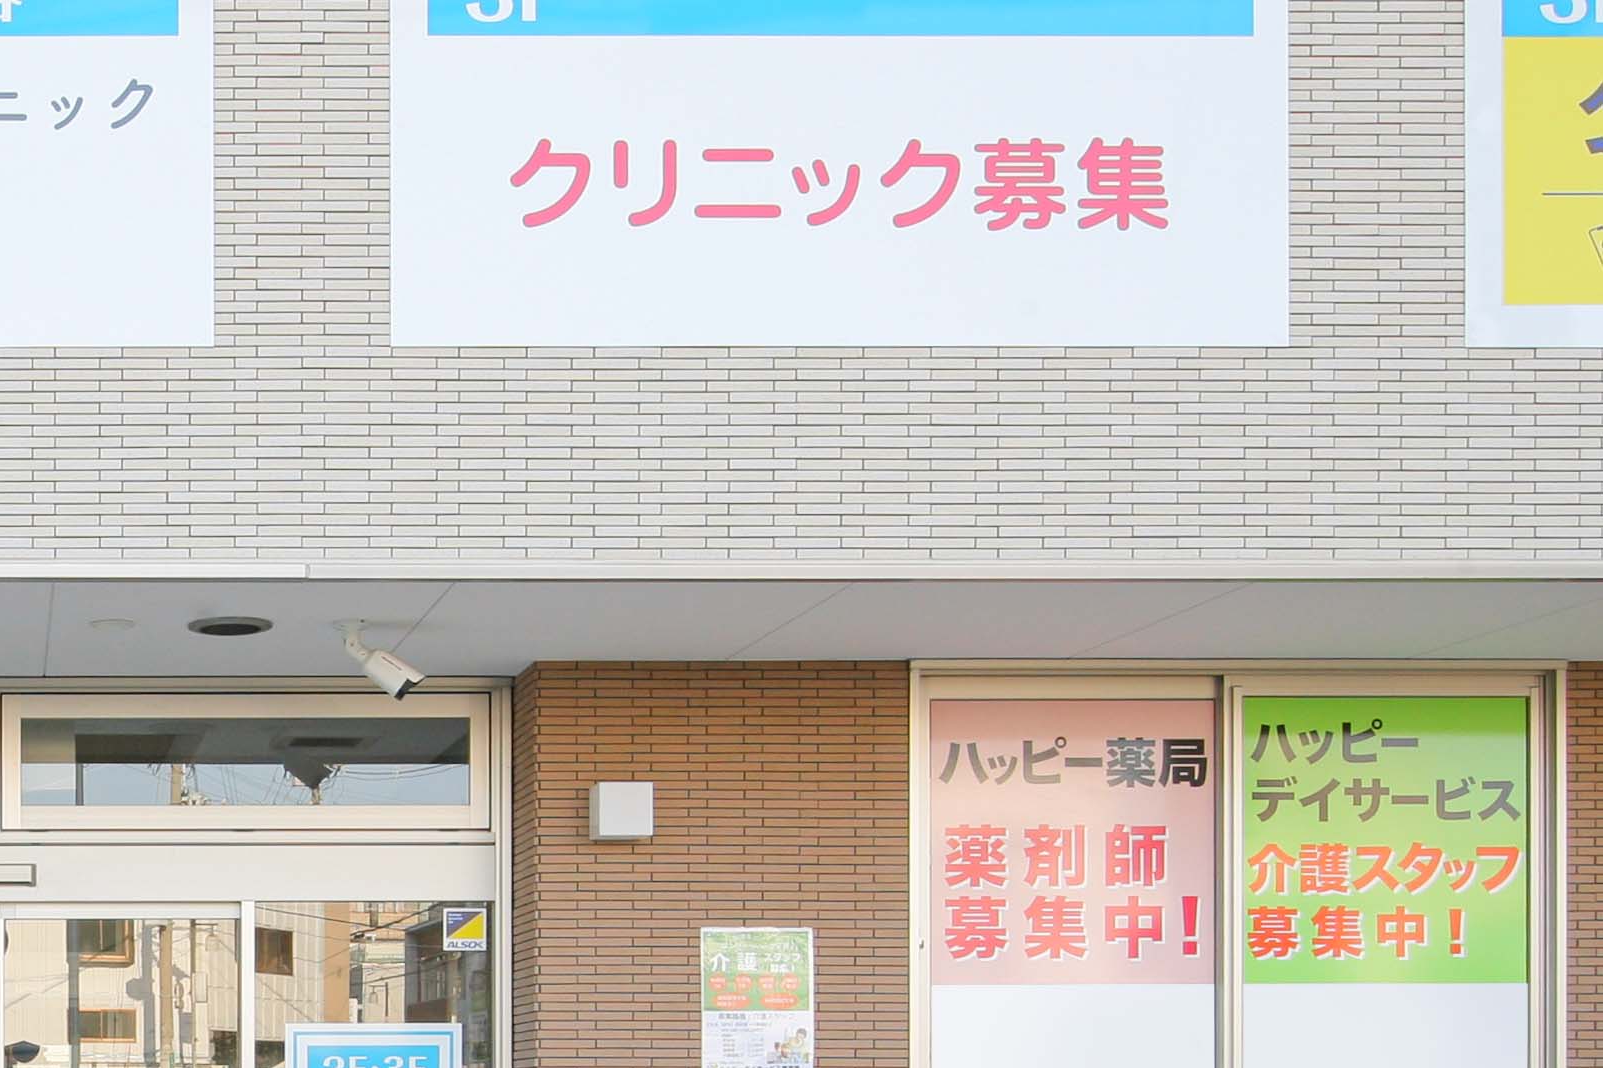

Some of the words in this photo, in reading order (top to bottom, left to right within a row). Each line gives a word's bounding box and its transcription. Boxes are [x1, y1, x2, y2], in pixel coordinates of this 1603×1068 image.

[508, 136, 1170, 233] クリニック募集
[939, 735, 1208, 789] ハッピー薬局
[1249, 717, 1419, 765] ハッピー
[1251, 776, 1522, 823] デイサービス
[944, 823, 1169, 889] 薬剤師
[1248, 841, 1522, 895] 介護スタッフ
[447, 940, 485, 949] ALSOK
